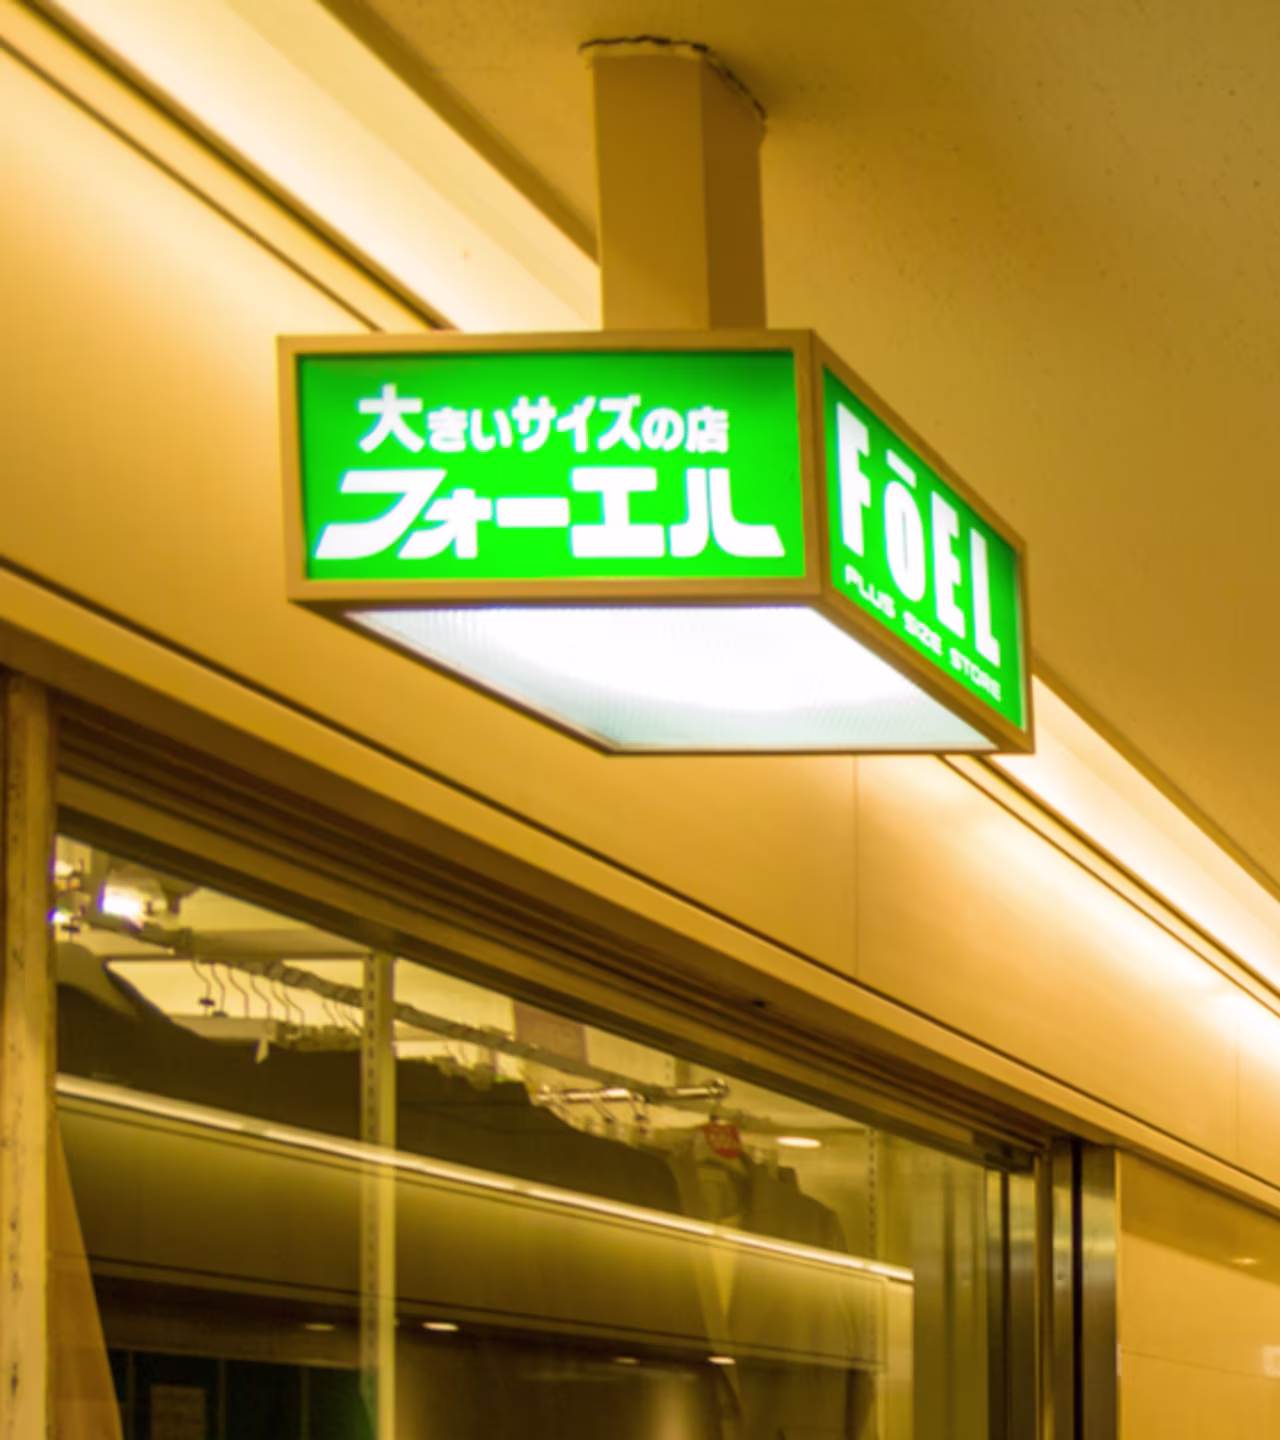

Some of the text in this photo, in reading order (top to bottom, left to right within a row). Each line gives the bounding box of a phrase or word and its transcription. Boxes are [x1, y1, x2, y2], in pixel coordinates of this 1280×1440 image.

[358, 384, 730, 454] 大きいサイズの店
[313, 467, 786, 560] フォーエル
[844, 564, 1003, 703] PLUS SIZE STORE
